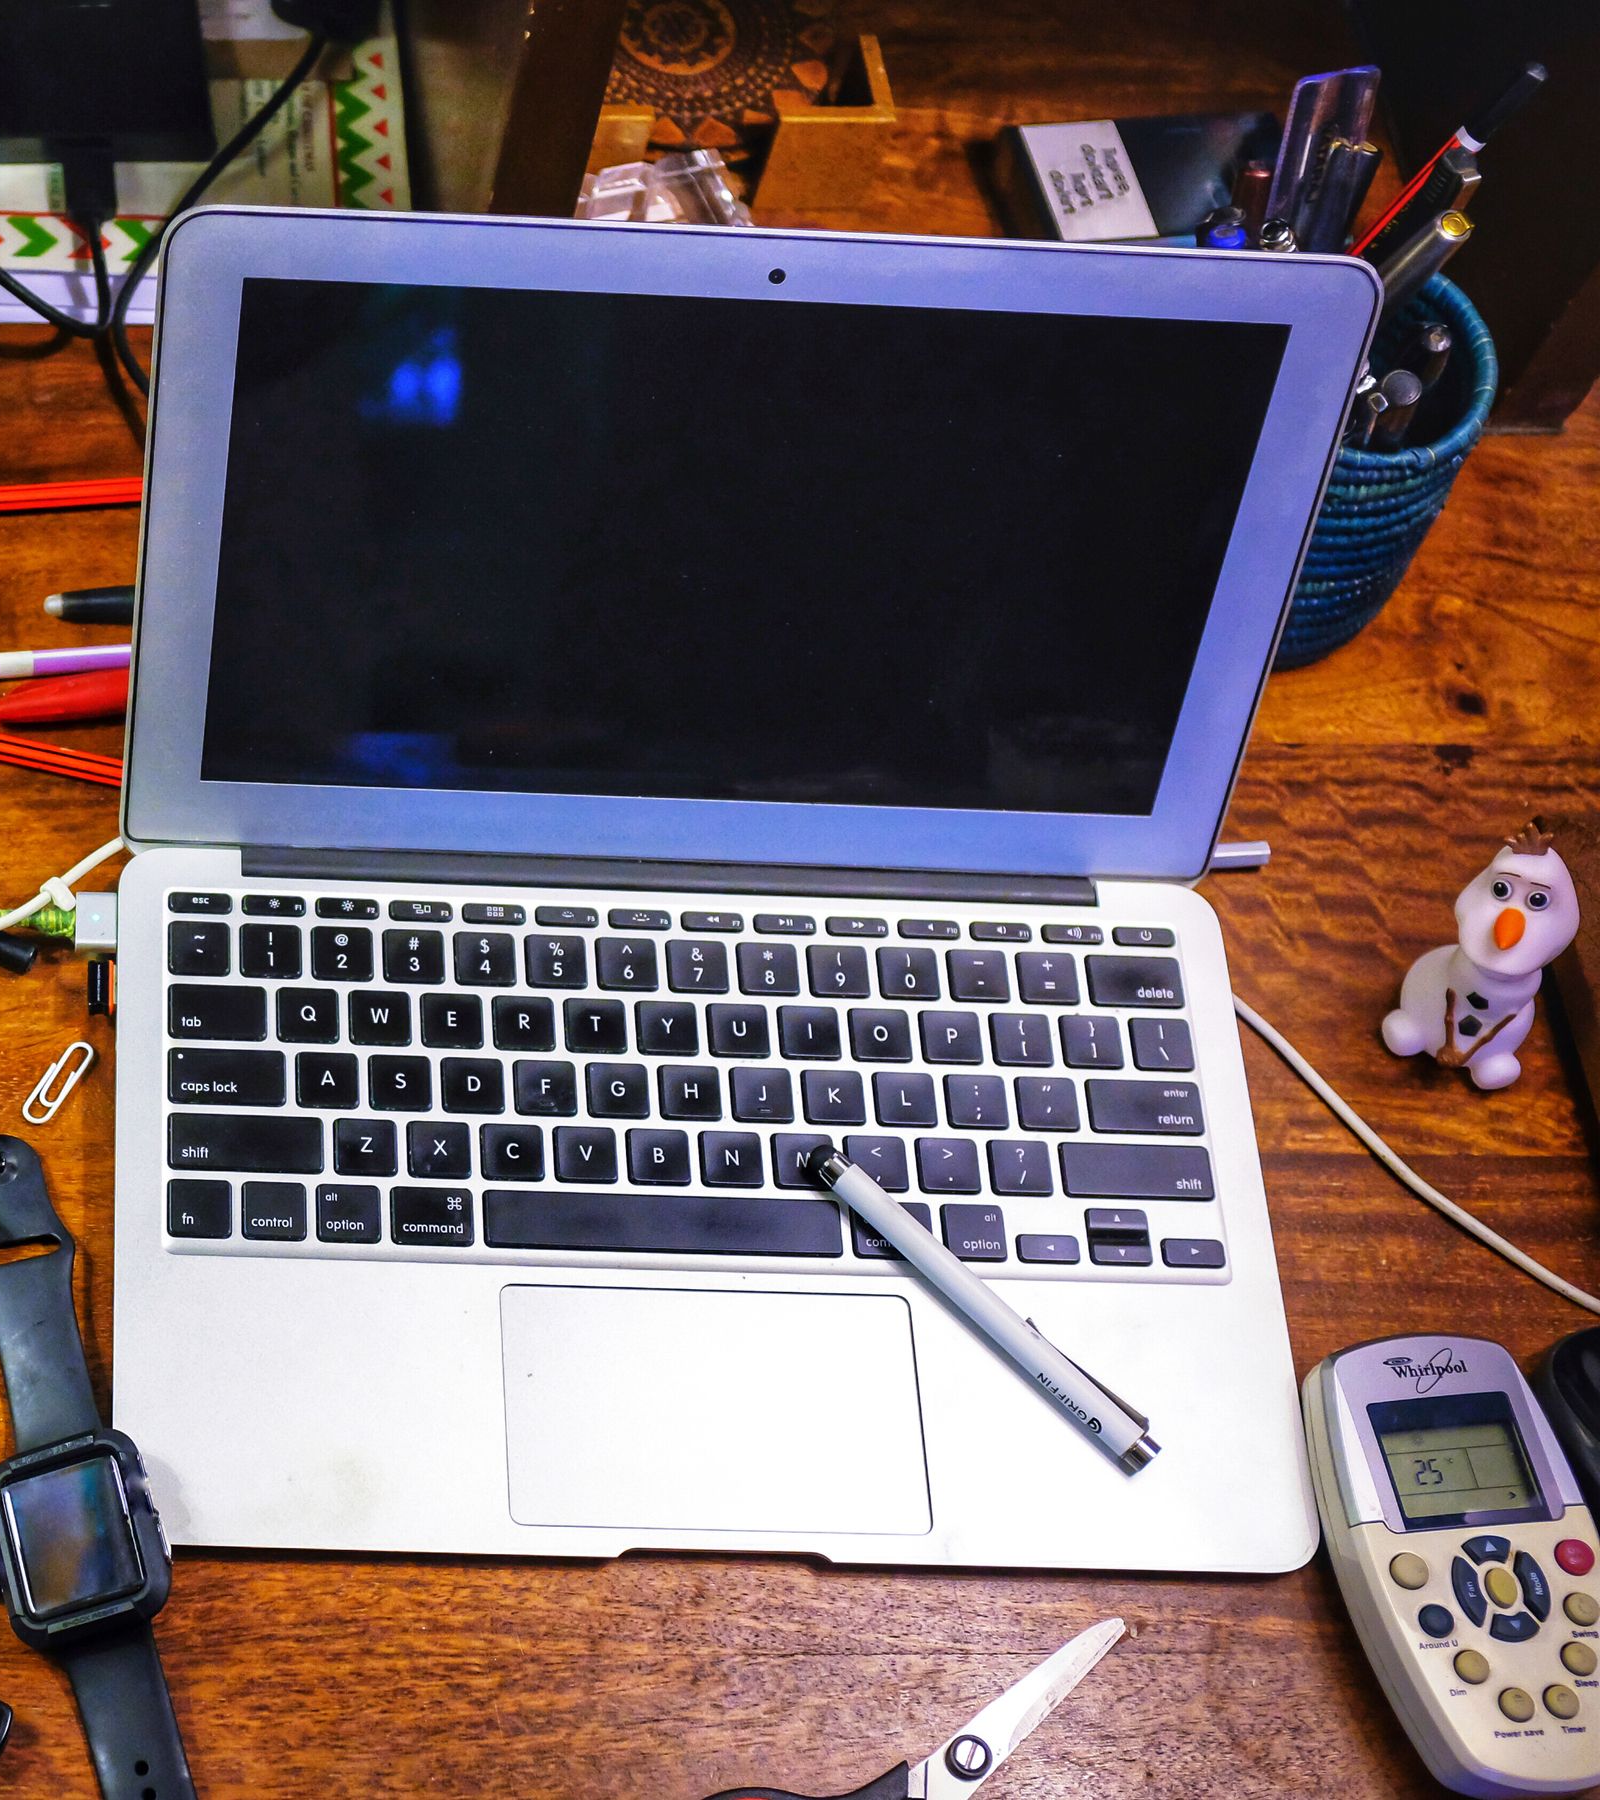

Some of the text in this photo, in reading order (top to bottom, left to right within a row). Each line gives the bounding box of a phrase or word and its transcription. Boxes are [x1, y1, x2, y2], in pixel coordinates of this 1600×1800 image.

[268, 952, 273, 966] 1
[337, 954, 347, 968] 2
[410, 957, 419, 971] 3
[480, 960, 491, 974] 4
[553, 962, 562, 976] 5
[624, 965, 633, 979] 6
[694, 968, 703, 982] 7
[765, 970, 775, 984] 8
[836, 972, 845, 986] 9
[905, 974, 915, 988] 0
[1138, 987, 1173, 998] delete
[301, 1006, 316, 1021] Q
[371, 1008, 388, 1023] W
[447, 1011, 457, 1026] E
[182, 1016, 201, 1027] tab
[519, 1014, 530, 1029] R
[590, 1016, 600, 1031] T
[662, 1018, 673, 1033] Y
[733, 1021, 746, 1036] U
[808, 1023, 812, 1039] I
[874, 1026, 888, 1041] O
[947, 1028, 957, 1043] P
[321, 1070, 335, 1086] A
[396, 1073, 406, 1088] S
[468, 1076, 480, 1091] D
[181, 1081, 237, 1093] caps lock
[541, 1079, 550, 1094] F
[611, 1081, 625, 1096] G
[684, 1083, 698, 1098] H
[759, 1086, 766, 1101] J
[1164, 1089, 1188, 1097] enter
[828, 1088, 841, 1103] K
[901, 1090, 911, 1106] L
[1159, 1115, 1193, 1124] return
[182, 1146, 208, 1158] shift
[361, 1137, 373, 1152] Z
[434, 1140, 447, 1155] X
[507, 1143, 519, 1159] C
[580, 1145, 592, 1161] V
[653, 1148, 664, 1163] B
[725, 1150, 739, 1165] N
[1176, 1179, 1201, 1189] shift
[326, 1193, 337, 1201] alt
[182, 1213, 193, 1224] fn
[252, 1217, 292, 1227] control
[326, 1220, 364, 1231] option
[403, 1223, 463, 1233] command
[963, 1239, 1000, 1251] option
[1391, 1360, 1469, 1379] Whirlpool
[1037, 1372, 1088, 1421] GRIFFIN
[1414, 1459, 1444, 1485] 25
[1466, 1581, 1477, 1598] Fan
[1530, 1572, 1543, 1595] Mode
[1571, 1630, 1599, 1639] Swing
[1419, 1640, 1458, 1650] Around U
[1574, 1680, 1599, 1688] Sleep
[1450, 1689, 1467, 1697] Dim
[1494, 1729, 1544, 1739] Power save
[1561, 1725, 1587, 1733] Timer
